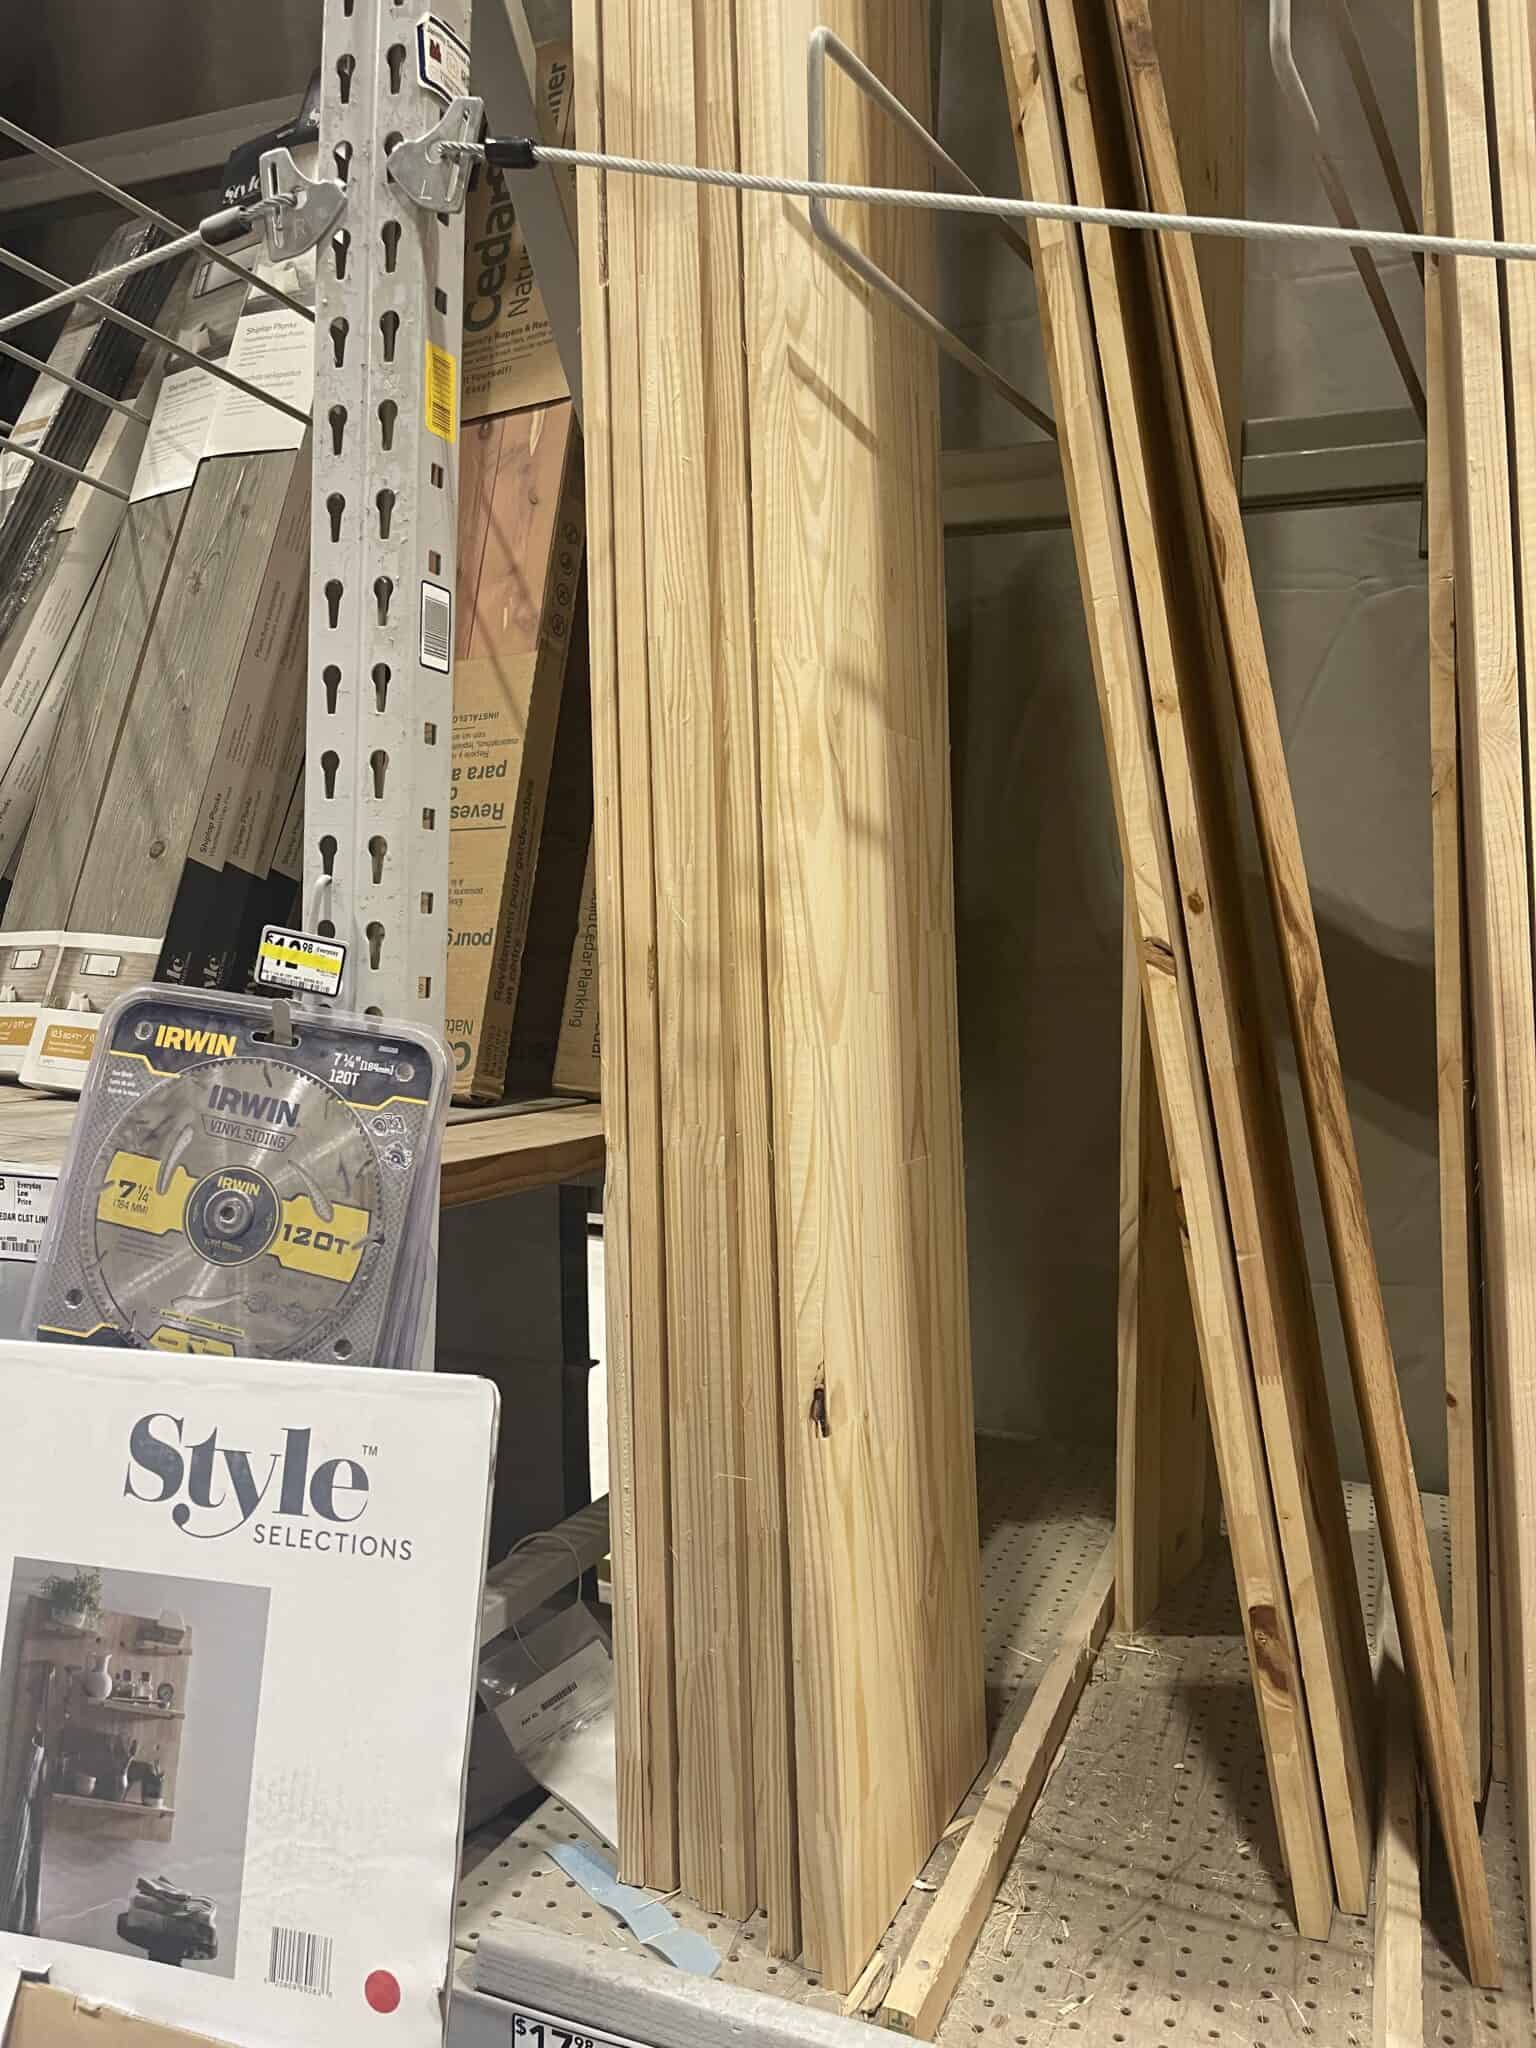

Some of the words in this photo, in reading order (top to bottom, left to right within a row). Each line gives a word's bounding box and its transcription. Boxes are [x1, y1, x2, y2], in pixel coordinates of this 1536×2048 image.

[467, 760, 507, 780] para
[569, 968, 593, 1029] Planking
[155, 1024, 237, 1057] IRWIN
[329, 1069, 360, 1086] 120T
[208, 1084, 300, 1127] IRWIN
[210, 1119, 241, 1139] VINYL
[243, 1128, 286, 1149] SIDING
[17, 1181, 42, 1192] Everyday
[217, 1175, 260, 1196] IRWIN
[283, 1223, 350, 1255] 120T
[123, 1412, 369, 1539] Style
[253, 1523, 413, 1561] SELECTIONS
